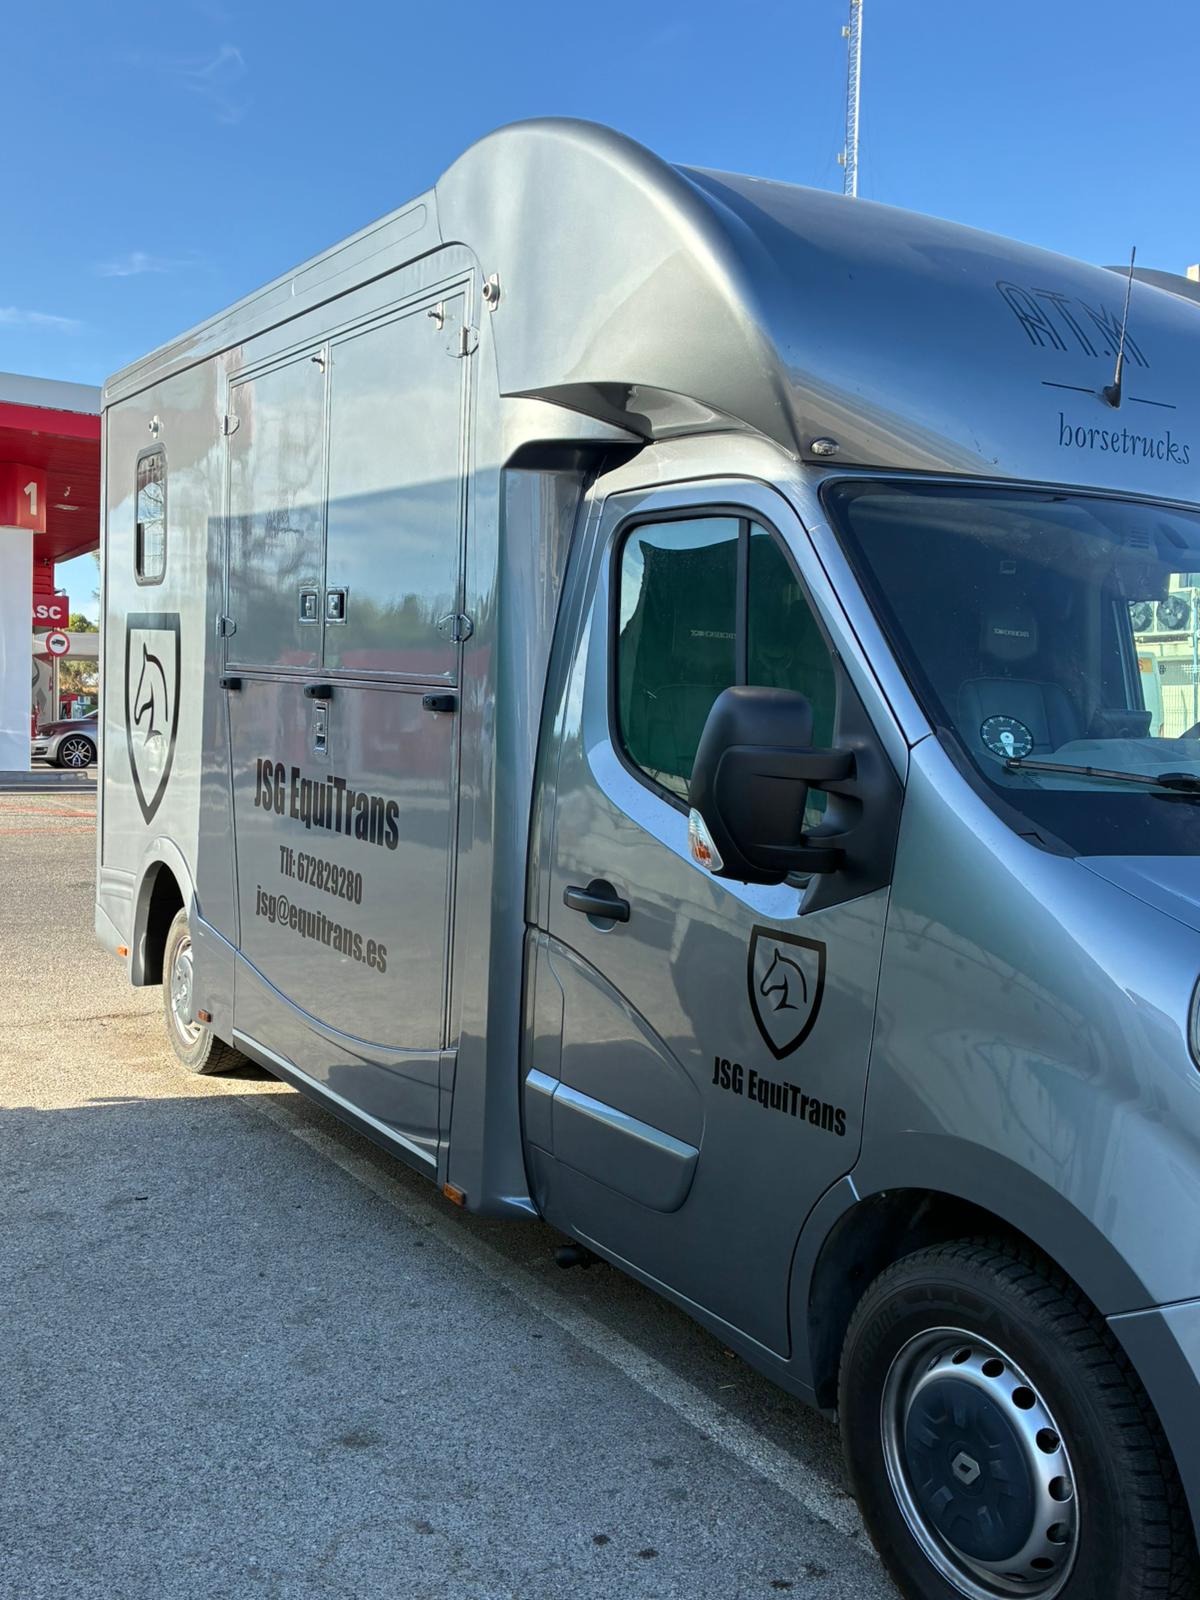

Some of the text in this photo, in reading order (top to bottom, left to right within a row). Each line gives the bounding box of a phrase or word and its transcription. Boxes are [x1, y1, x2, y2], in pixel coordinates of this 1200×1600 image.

[1059, 412, 1190, 464] horsetrucks
[23, 481, 38, 516] 1
[254, 759, 400, 850] JSG EquiTrans
[279, 845, 363, 905] Tlf: 672829280
[256, 885, 388, 973] jsg@equitrans.es
[712, 1056, 847, 1137] JSG EquiTrans
